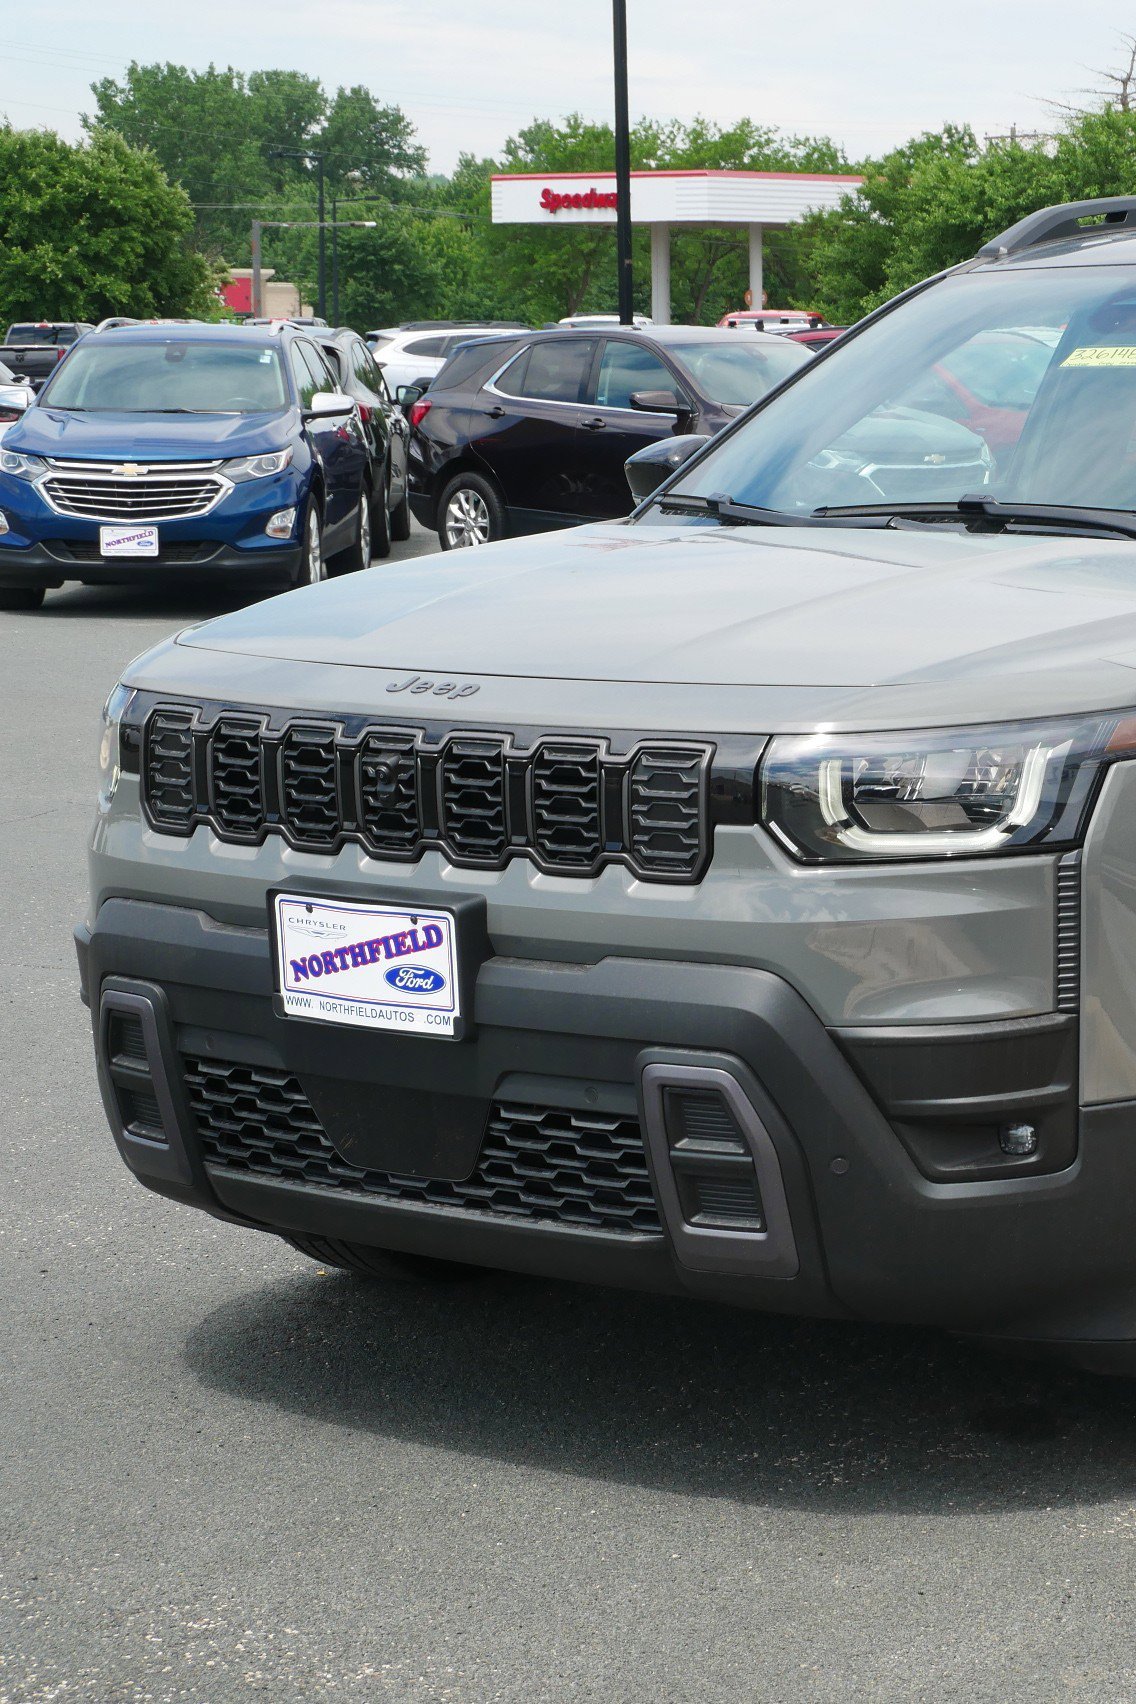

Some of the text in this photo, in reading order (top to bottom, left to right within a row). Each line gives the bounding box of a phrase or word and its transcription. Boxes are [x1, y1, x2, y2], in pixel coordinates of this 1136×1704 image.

[540, 188, 618, 214] Speedwa
[385, 675, 480, 700] Jeep
[288, 917, 347, 931] CHRYSLER
[290, 924, 444, 982] NORTHFIELD
[395, 967, 435, 990] Ford
[285, 995, 314, 1009] WWW.
[319, 1000, 415, 1022] NORTHFIELDAUTOS
